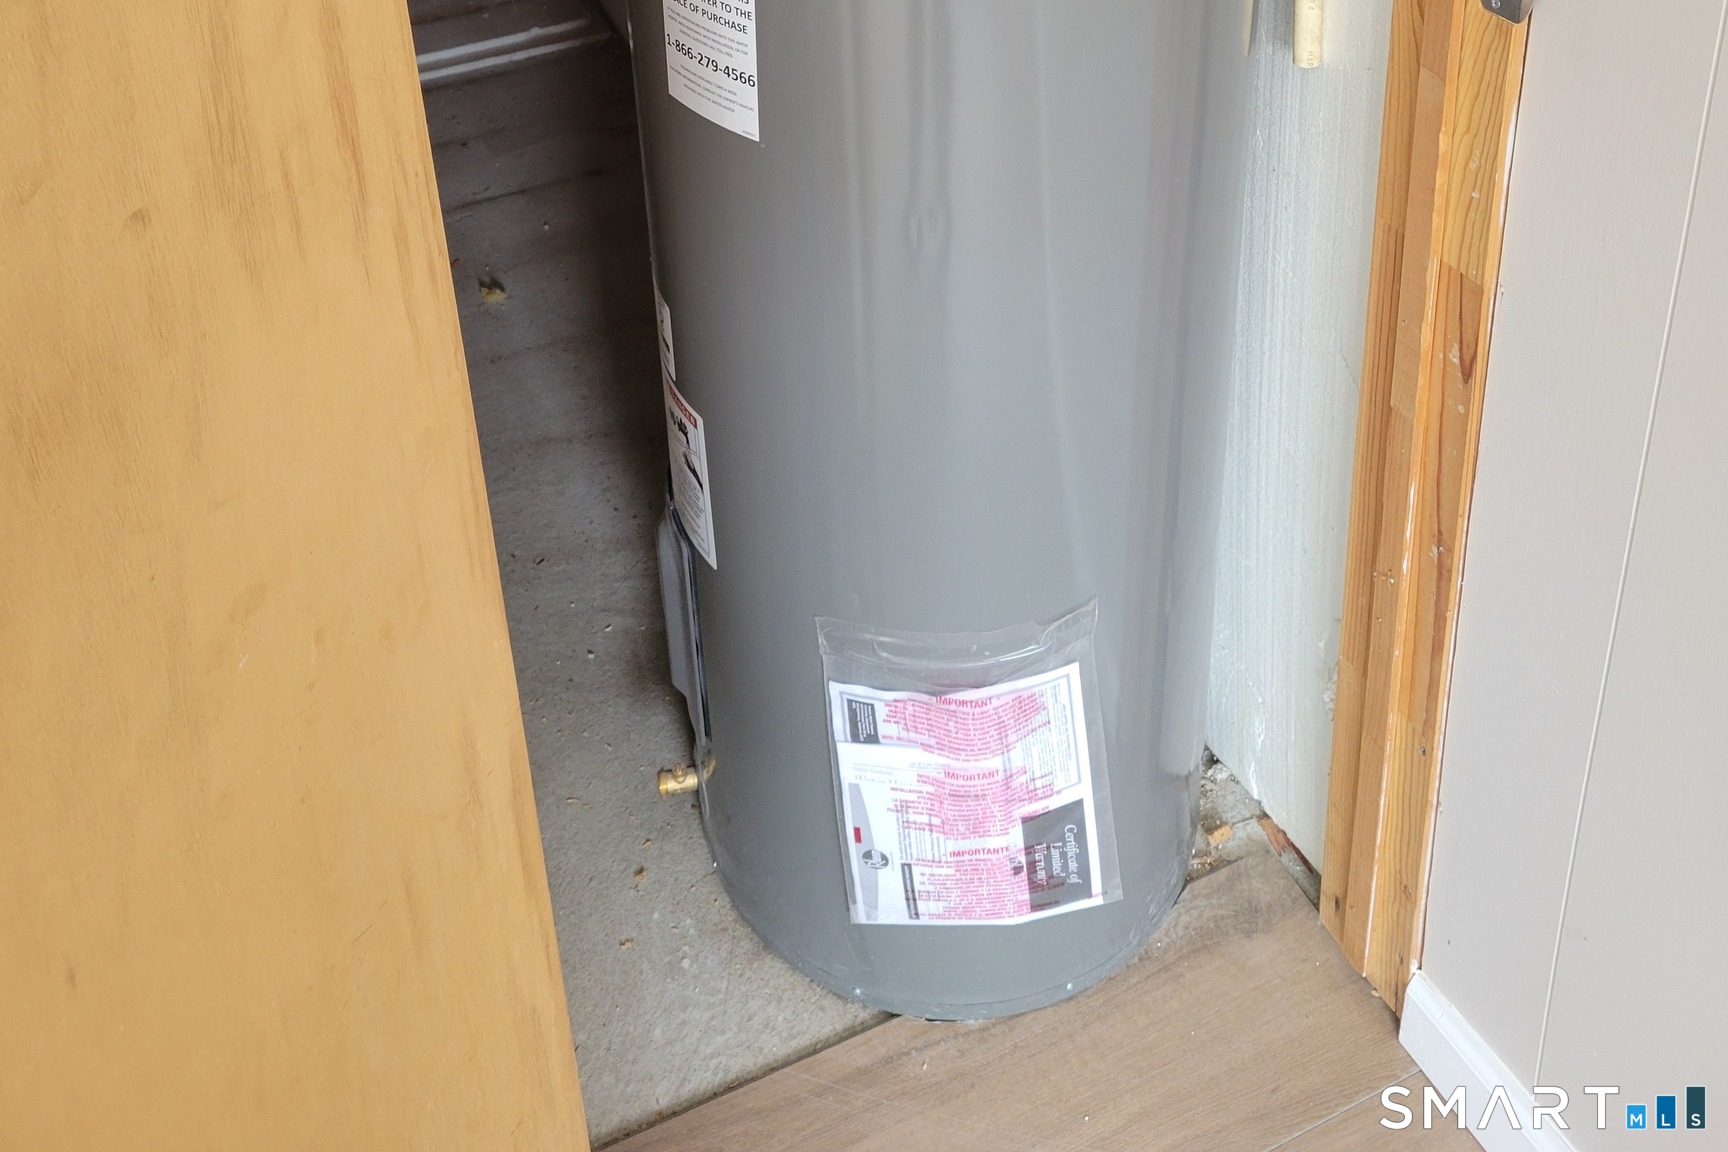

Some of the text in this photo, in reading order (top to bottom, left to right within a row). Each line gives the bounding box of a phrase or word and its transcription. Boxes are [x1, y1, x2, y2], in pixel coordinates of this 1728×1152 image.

[689, 3, 700, 14] OF
[702, 9, 748, 34] PURCHASE
[720, 2, 732, 13] TO
[734, 7, 753, 21] THE
[666, 34, 756, 87] 1-866-279-4566
[935, 696, 993, 708] IMPORTANT
[944, 769, 1000, 782] IMPORTANT
[949, 847, 1009, 858] IMPORTANTE
[1050, 842, 1066, 877] Limited
[1064, 825, 1082, 884] Certificate of
